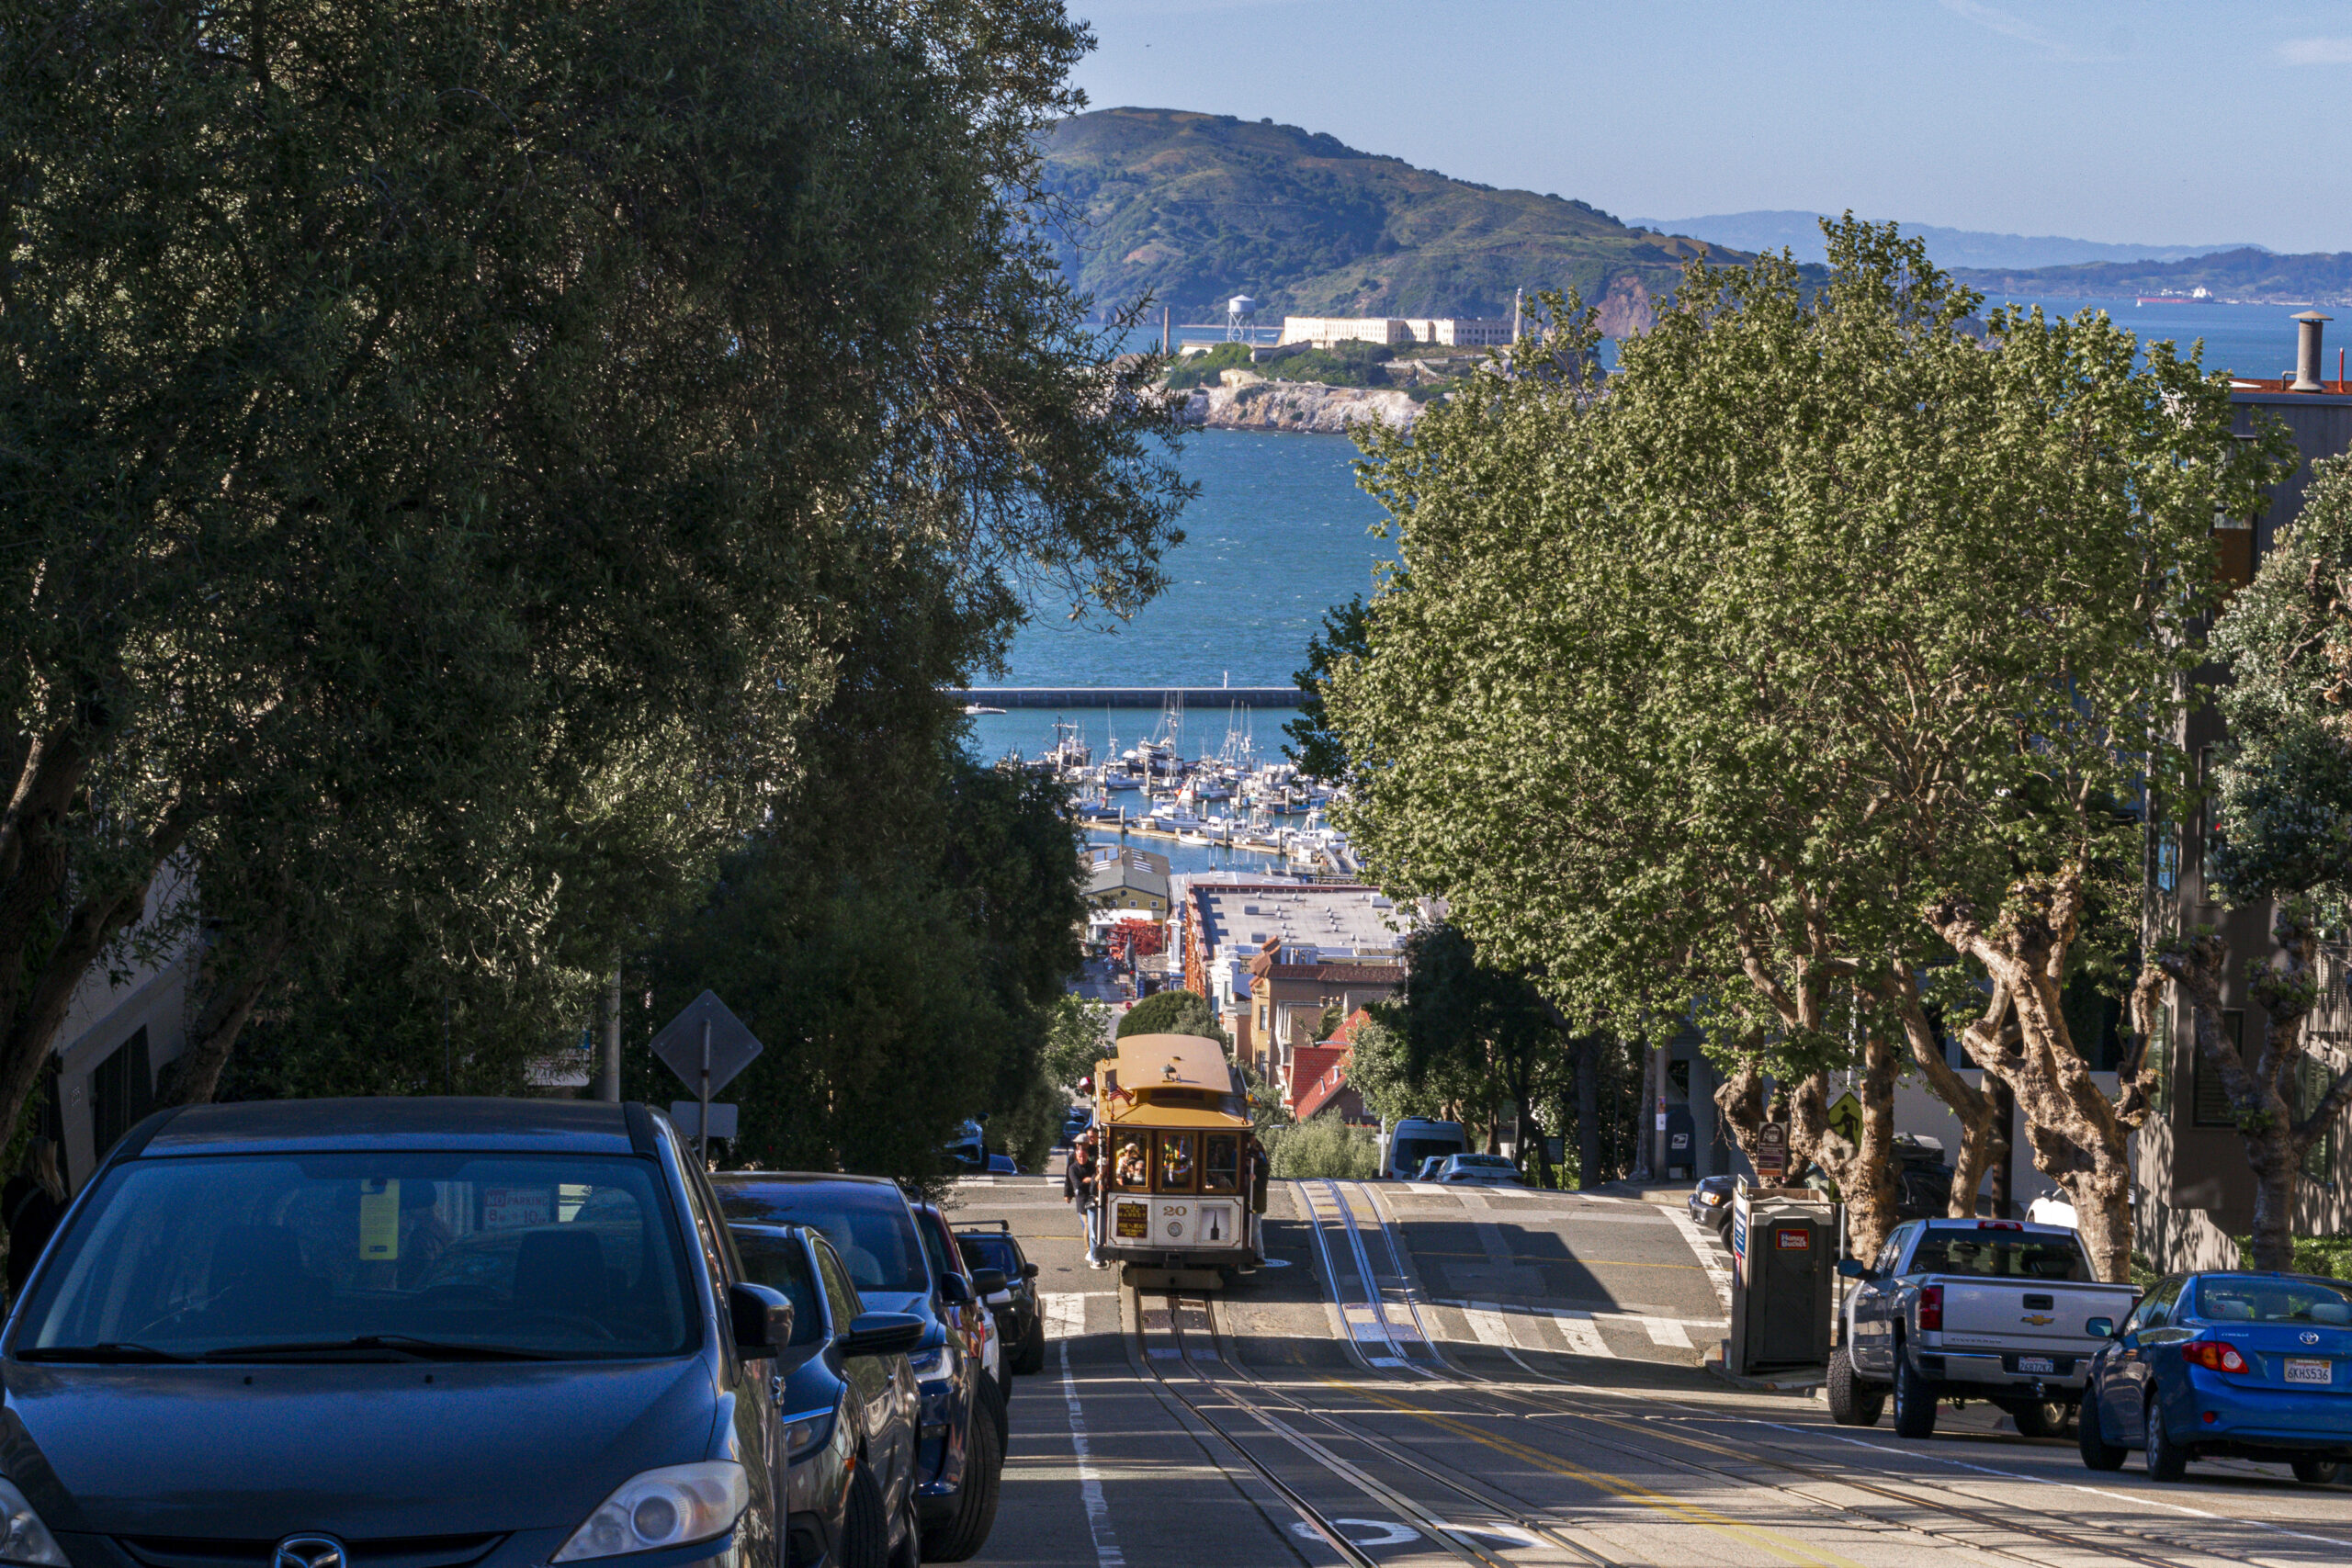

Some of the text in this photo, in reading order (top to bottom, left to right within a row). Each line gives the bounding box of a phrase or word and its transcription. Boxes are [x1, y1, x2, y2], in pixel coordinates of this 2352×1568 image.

[487, 1195, 548, 1207] NO PARKING
[1163, 1205, 1187, 1216] 20
[1781, 1234, 1805, 1242] Honey
[2288, 1367, 2329, 1381] 6KHS536
